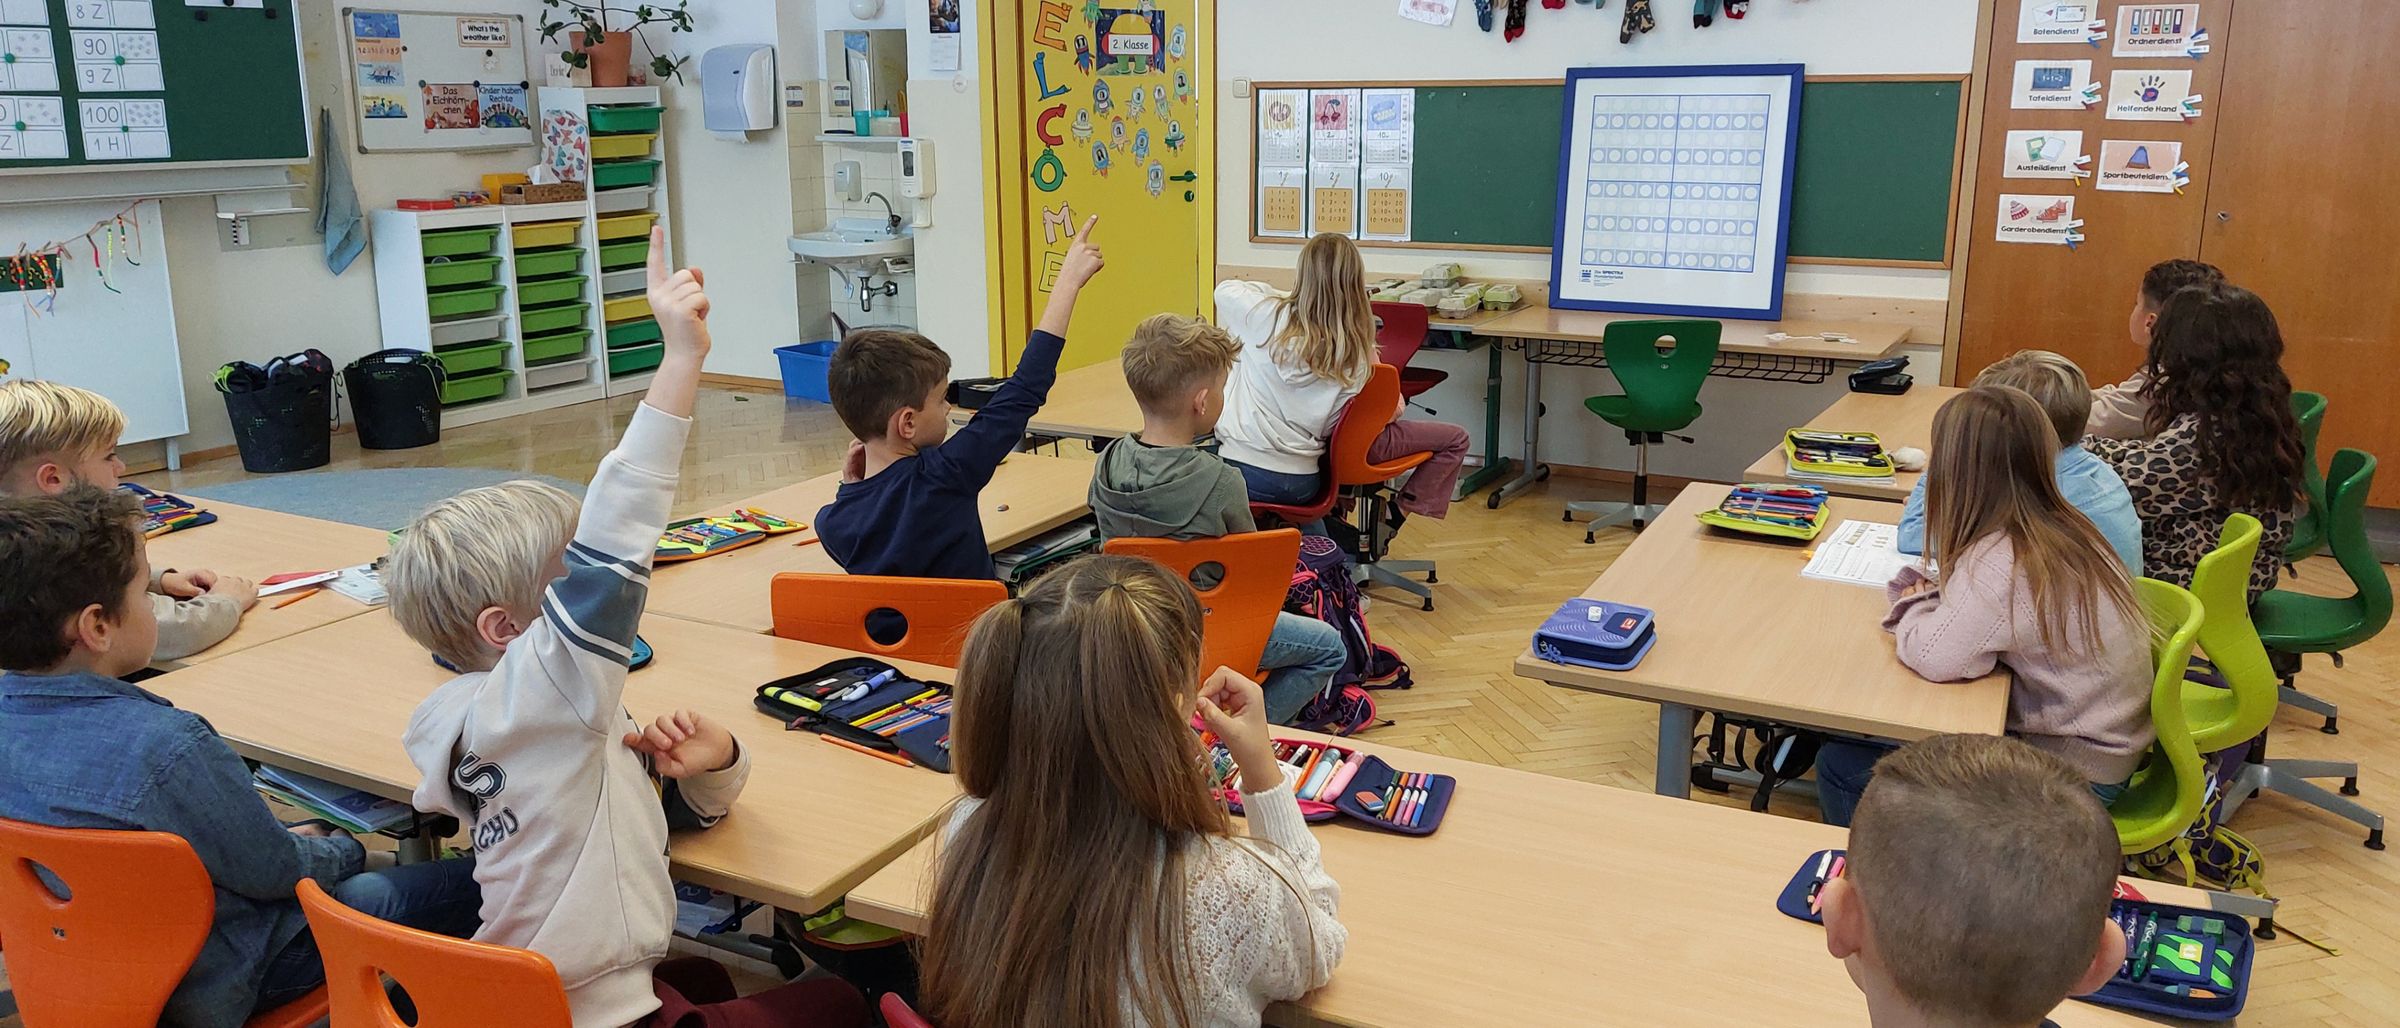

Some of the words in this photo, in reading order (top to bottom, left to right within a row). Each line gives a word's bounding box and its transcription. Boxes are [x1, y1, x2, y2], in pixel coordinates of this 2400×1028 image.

[76, 4, 85, 19] 8
[90, 4, 104, 19] Z
[84, 38, 107, 56] 90
[1123, 39, 1150, 50] Klasse
[85, 69, 95, 84] 9
[102, 68, 115, 84] Z
[442, 87, 458, 95] Das
[86, 106, 119, 123] 100
[94, 138, 101, 151] 1
[108, 136, 120, 151] H
